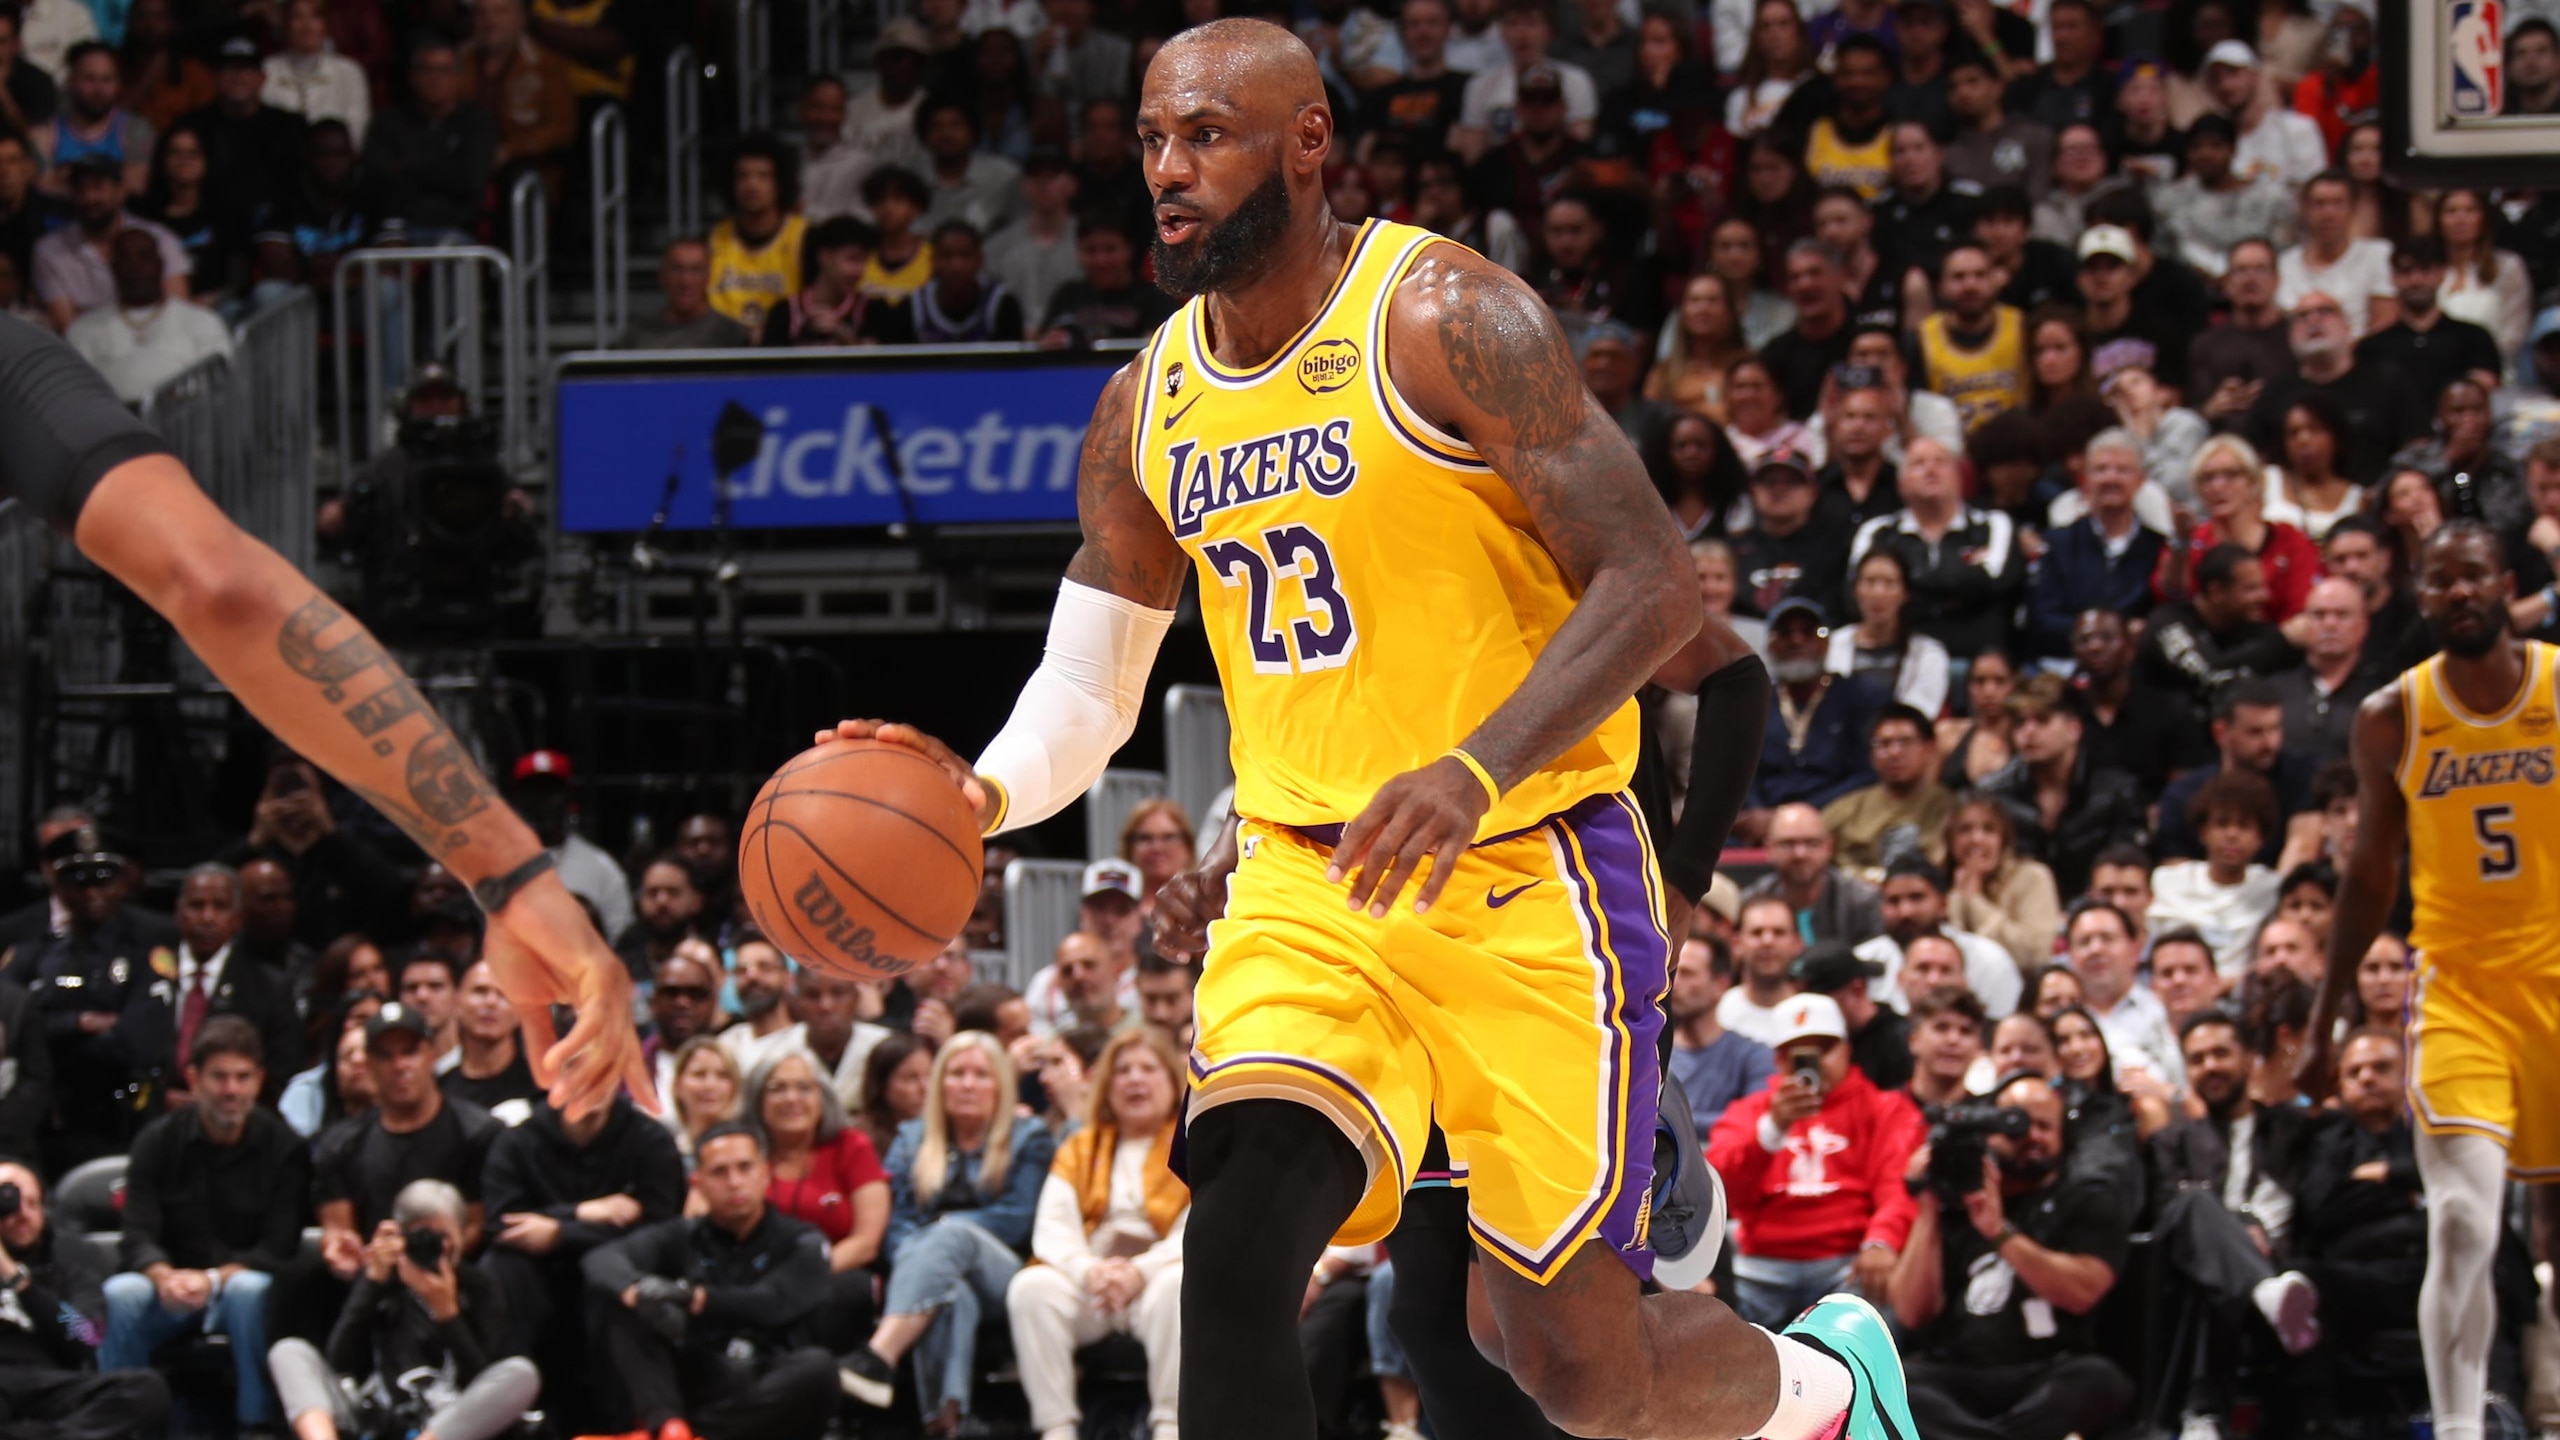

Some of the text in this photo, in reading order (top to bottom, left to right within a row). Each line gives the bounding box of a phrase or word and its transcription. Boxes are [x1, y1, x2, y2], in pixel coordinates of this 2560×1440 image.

[1303, 353, 1357, 375] bibigo
[1312, 371, 1335, 382] 비비고
[718, 403, 1087, 498] icketm
[1165, 417, 1359, 541] LAKERS
[1198, 522, 1358, 675] 23
[2416, 745, 2556, 799] LAKERS
[2473, 804, 2522, 881] 5
[794, 869, 916, 973] Wilson
